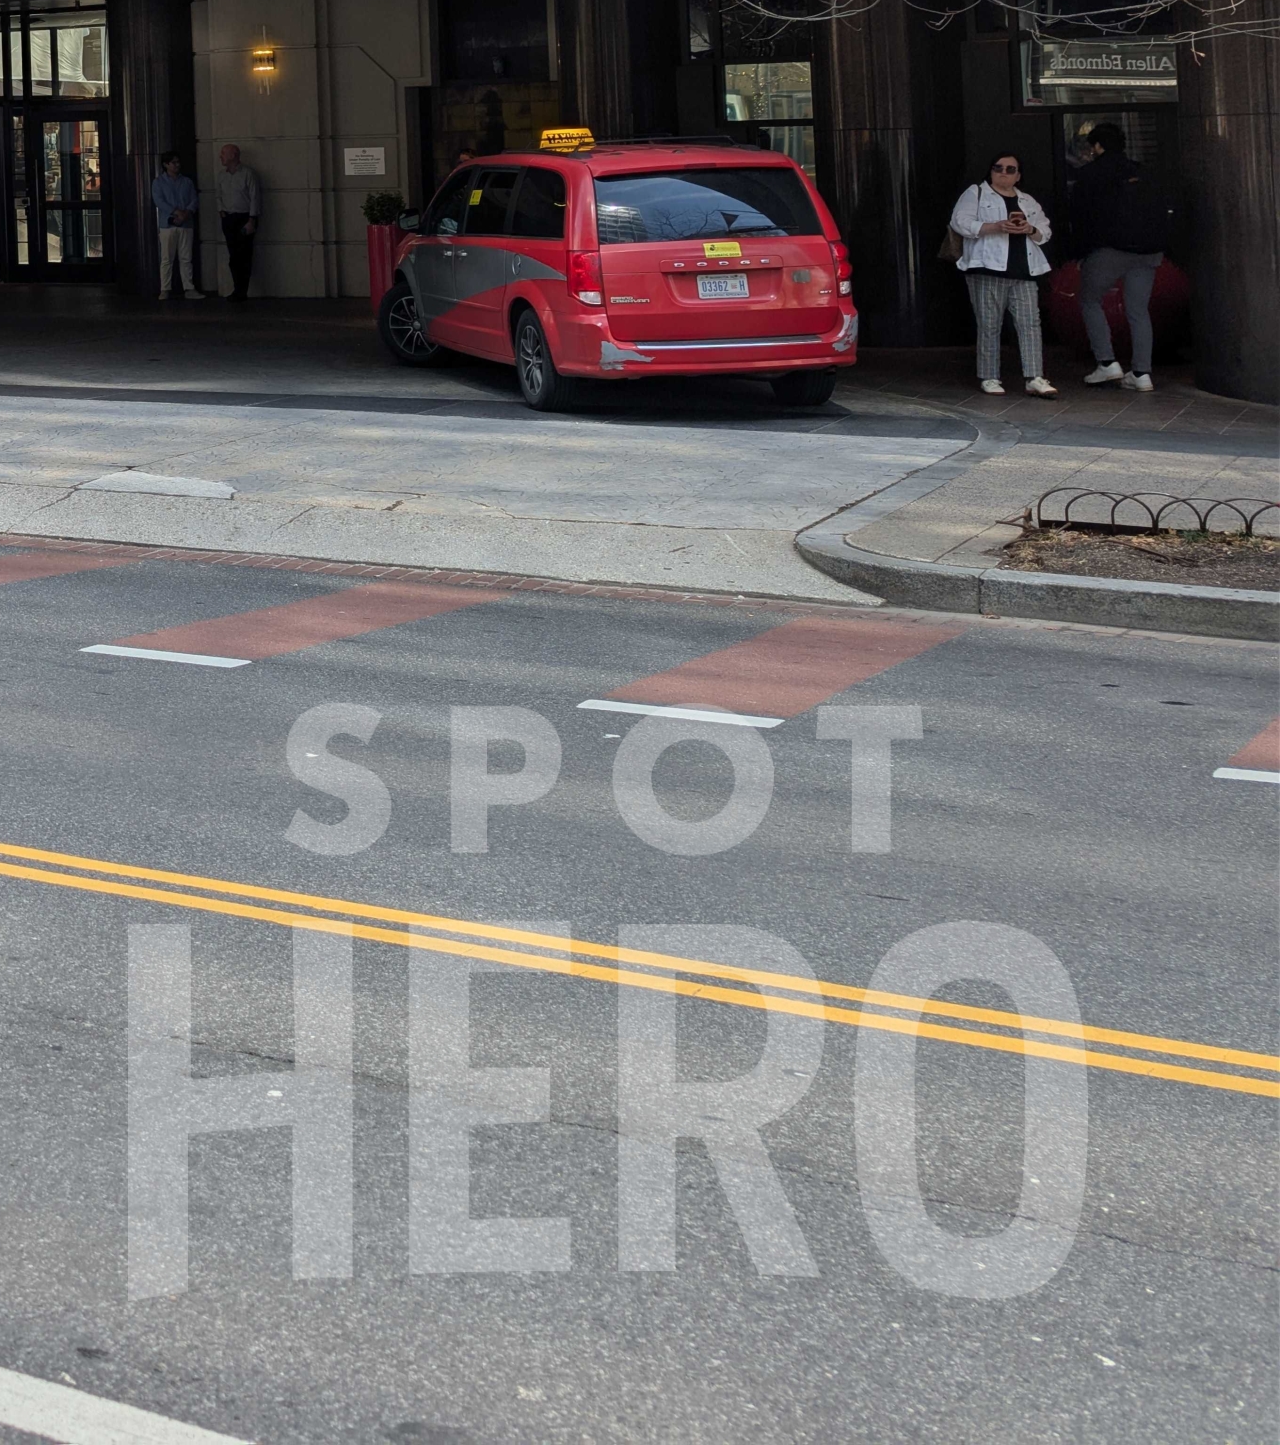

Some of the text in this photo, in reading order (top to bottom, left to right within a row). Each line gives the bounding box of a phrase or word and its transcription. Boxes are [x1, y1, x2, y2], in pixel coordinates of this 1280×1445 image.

[673, 258, 770, 267] DODGE
[701, 280, 746, 293] 03362 H
